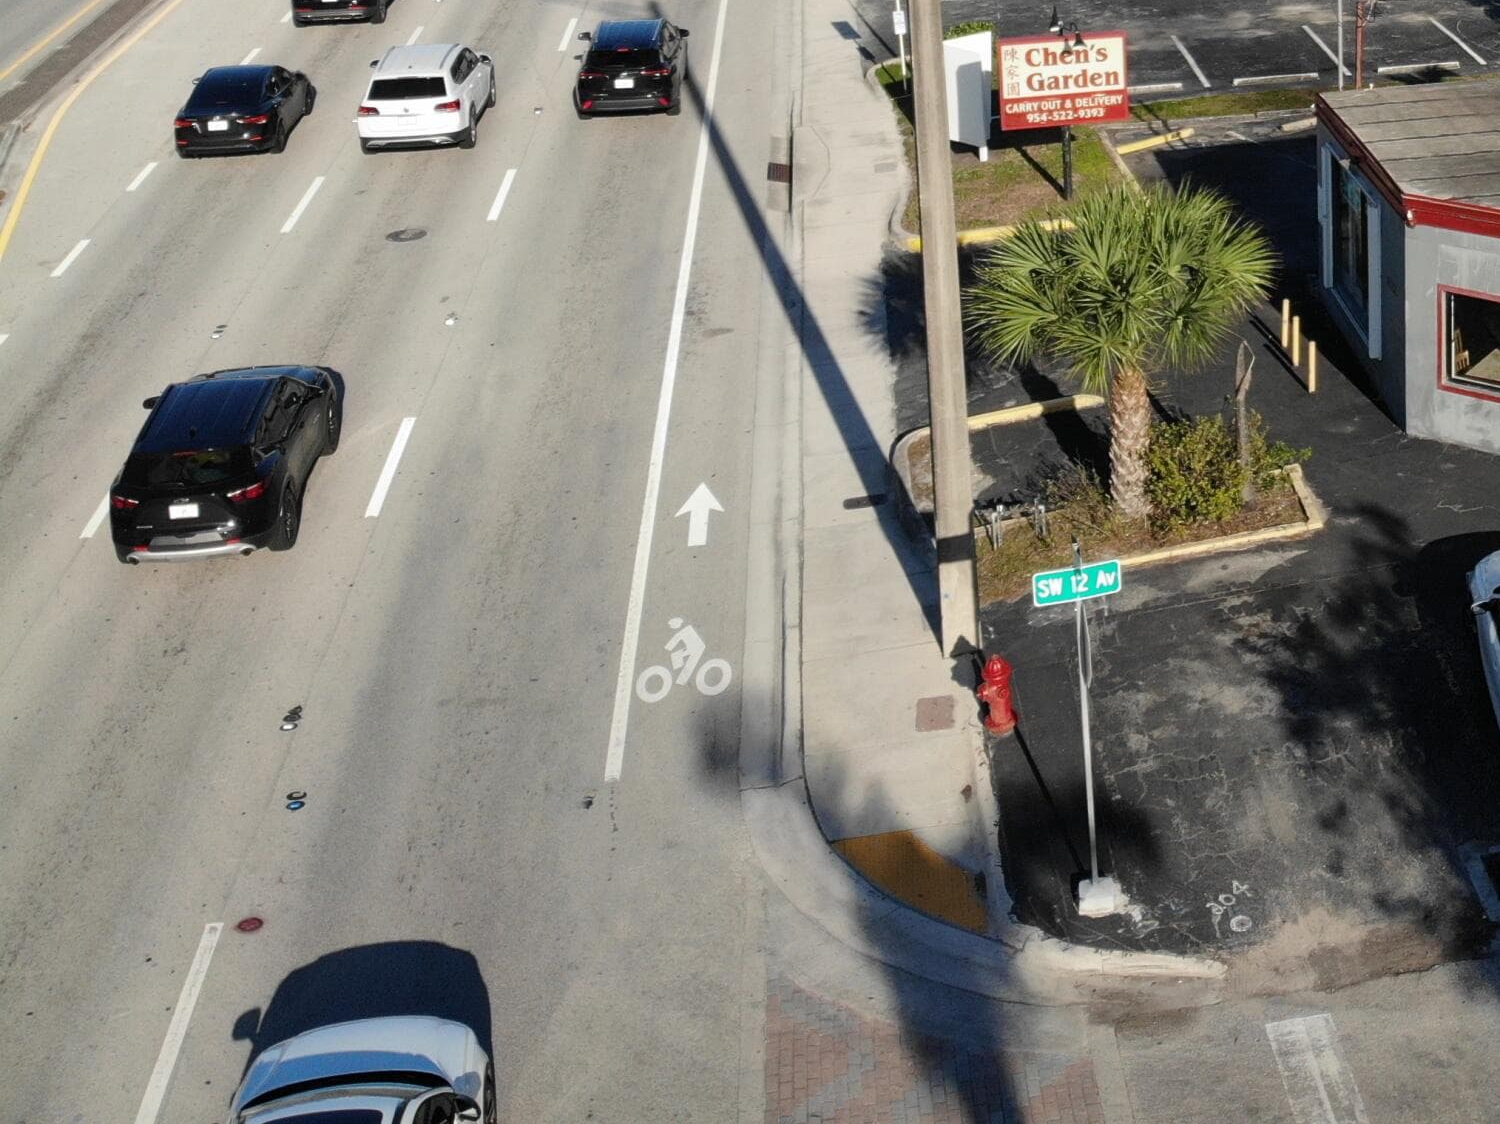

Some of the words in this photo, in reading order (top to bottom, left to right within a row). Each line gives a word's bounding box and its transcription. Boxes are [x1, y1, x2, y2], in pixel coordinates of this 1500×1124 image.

[1024, 44, 1108, 67] Chen's
[1026, 69, 1120, 92] Garden
[1005, 101, 1040, 114] CARRY
[1041, 99, 1062, 110] OUT
[1064, 99, 1072, 109] &
[1075, 94, 1124, 108] DELIVERY
[1026, 107, 1105, 124] 954-522-9393
[1037, 578, 1063, 598] SW
[1070, 574, 1089, 593] 12
[1096, 569, 1116, 589] Av
